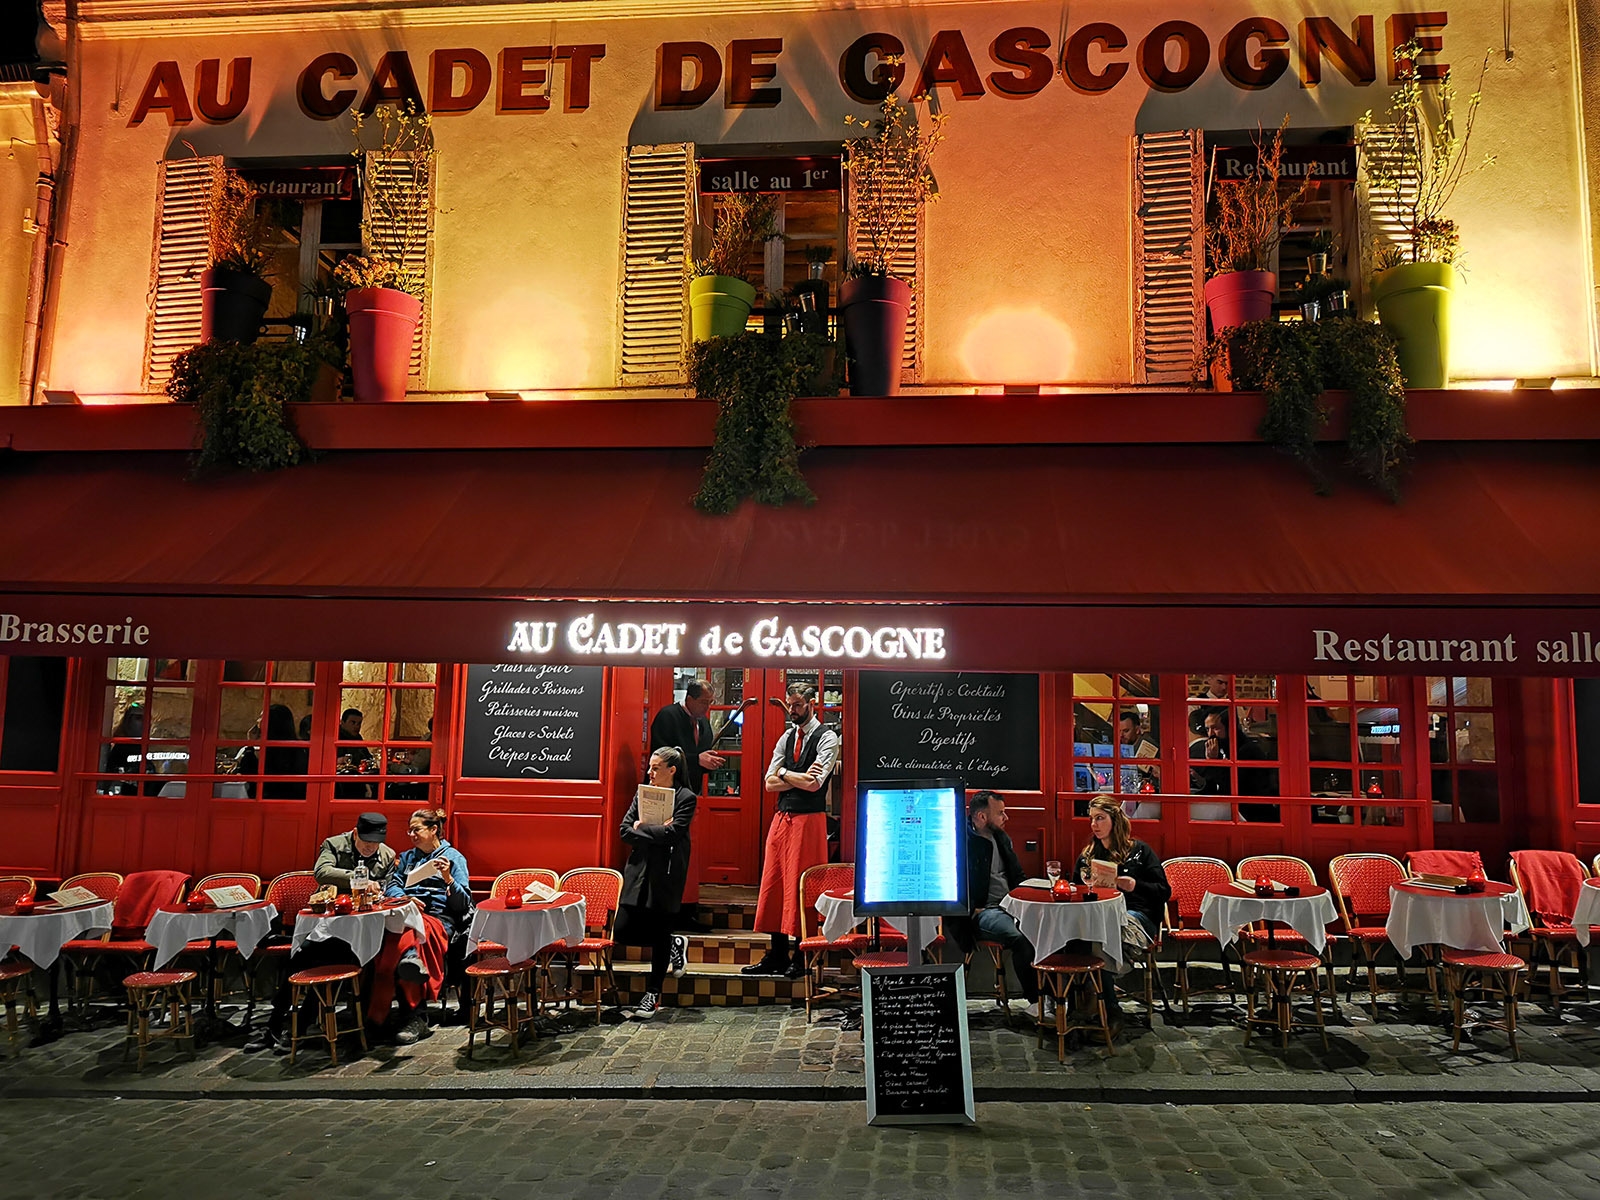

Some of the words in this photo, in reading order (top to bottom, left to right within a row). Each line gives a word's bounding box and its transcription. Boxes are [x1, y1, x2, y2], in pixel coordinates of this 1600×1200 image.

[127, 57, 252, 128] AU
[296, 44, 605, 121] CADET
[654, 38, 783, 112] DE
[838, 11, 1450, 105] GASCOGNE
[234, 179, 343, 195] estaurant
[711, 170, 760, 190] salle
[769, 176, 791, 189] au
[802, 169, 829, 189] 1er
[0, 614, 150, 645] Brasserie
[507, 621, 557, 654] AU
[567, 613, 687, 656] CADET
[699, 625, 744, 656] de
[750, 616, 946, 659] GASCOGNE
[1312, 629, 1518, 663] Restaurant
[524, 664, 537, 673] du
[478, 680, 530, 702] Grillades
[540, 680, 584, 695] Poissons
[890, 680, 944, 703] Apéritifs
[957, 683, 1006, 698] Cocktails
[485, 701, 541, 716] Patisseries
[542, 706, 579, 718] maison
[891, 703, 921, 719] Vins
[923, 709, 935, 719] de
[937, 706, 1002, 727] Propriétés
[490, 725, 526, 745] Glaces
[537, 726, 574, 740] Sorbets
[918, 727, 977, 753] Digestifs
[488, 746, 530, 767] Crêpes
[538, 747, 572, 762] Snack
[876, 756, 902, 768] Salle
[904, 758, 952, 770] climatisée
[955, 761, 964, 770] à
[967, 757, 1009, 776] l'étage
